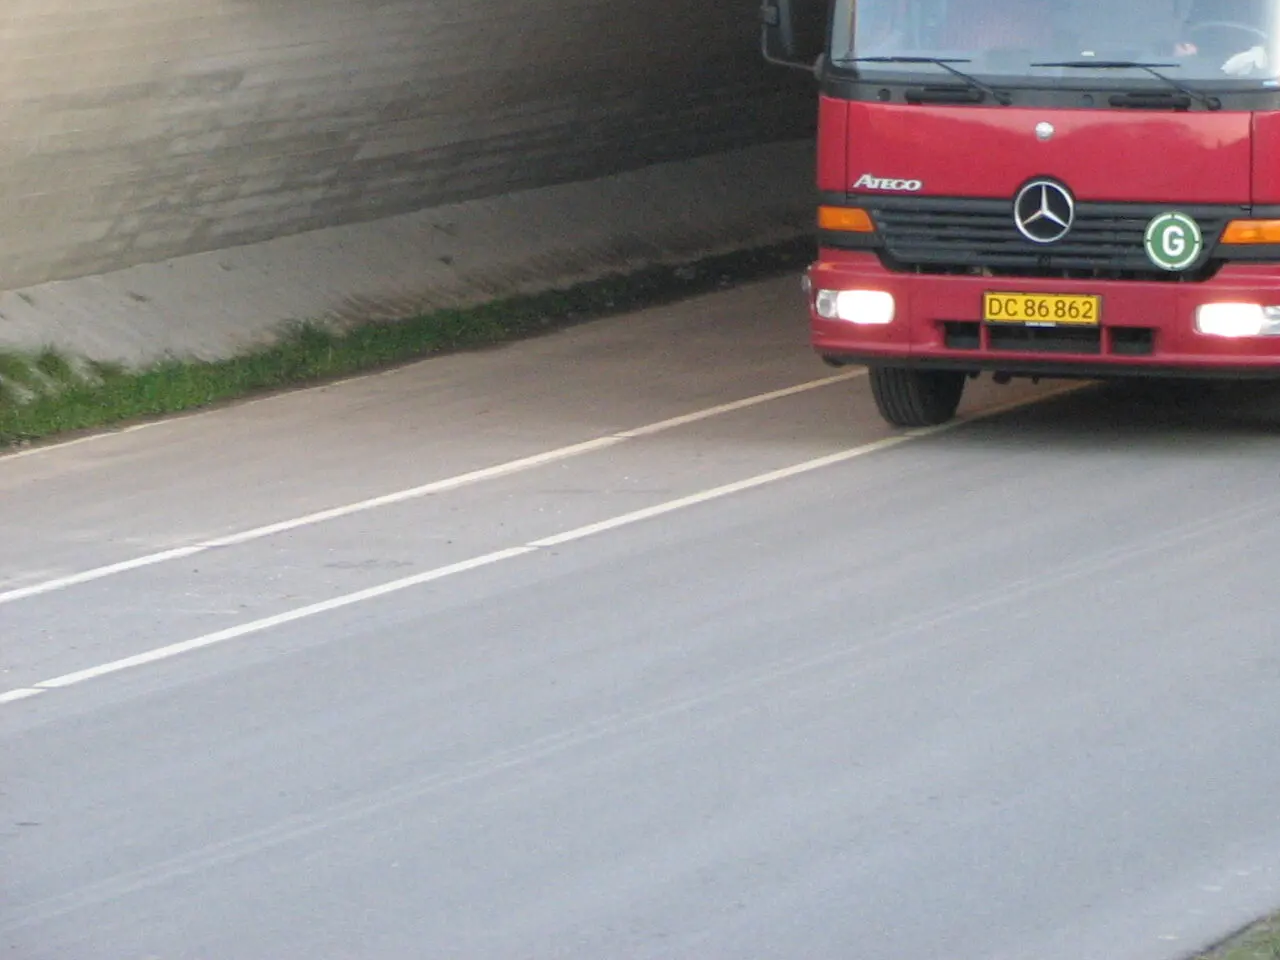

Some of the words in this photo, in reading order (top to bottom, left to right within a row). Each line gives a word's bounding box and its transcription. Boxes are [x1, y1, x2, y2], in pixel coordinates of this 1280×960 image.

[1162, 225, 1185, 257] G
[988, 297, 1018, 317] DC
[1024, 299, 1049, 318] 86
[1054, 299, 1093, 319] 862
